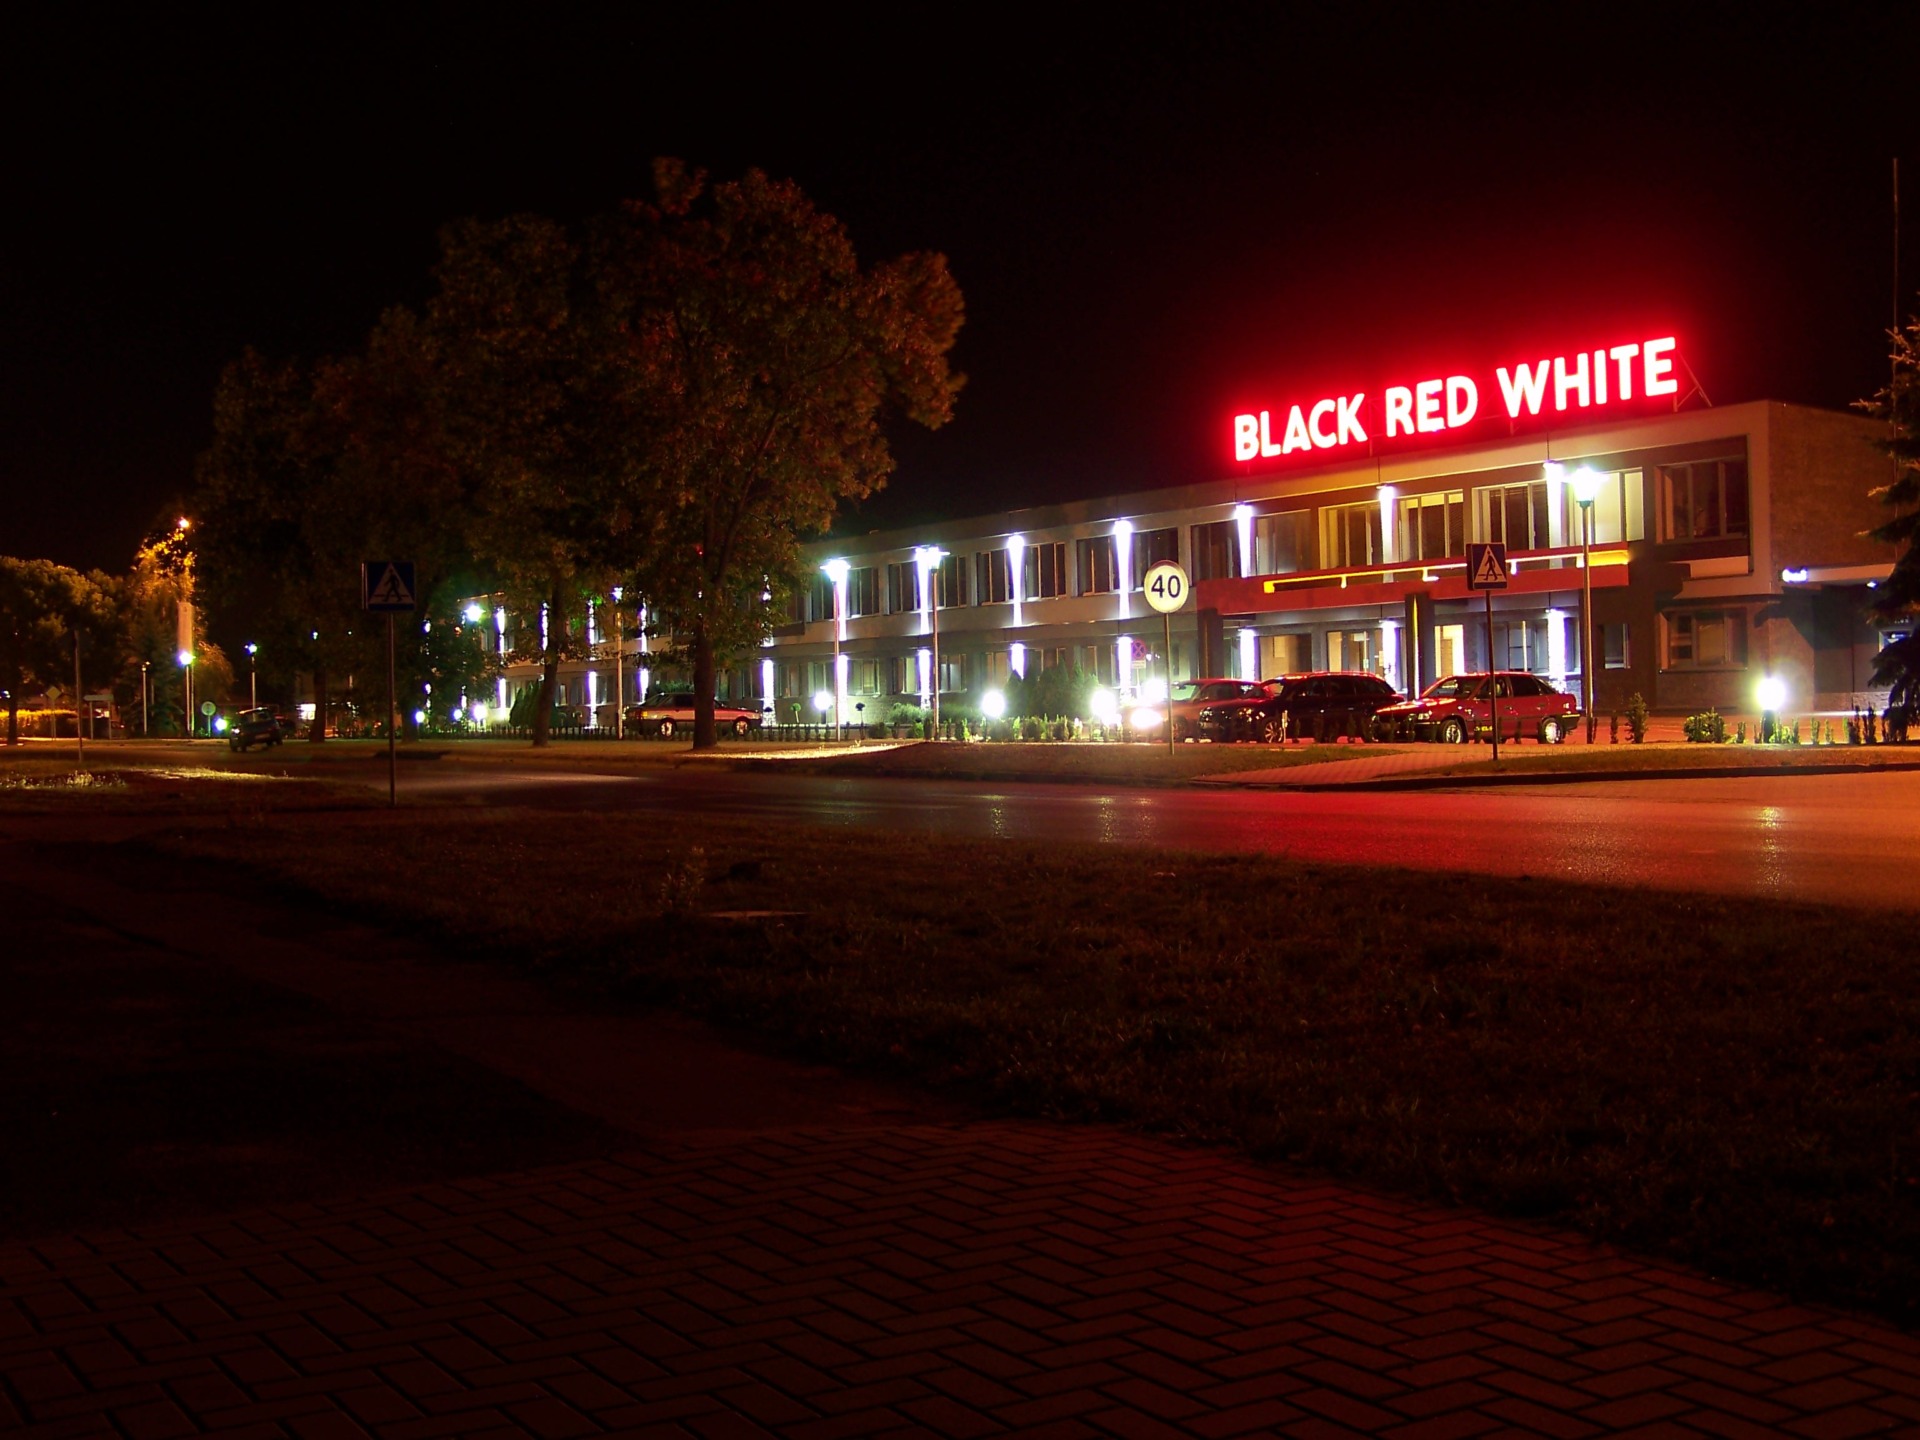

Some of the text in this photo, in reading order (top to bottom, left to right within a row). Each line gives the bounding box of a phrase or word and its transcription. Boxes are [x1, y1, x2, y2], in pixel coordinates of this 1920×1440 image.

[1235, 336, 1679, 462] BLACK RED WHITE
[1151, 575, 1181, 598] 40
